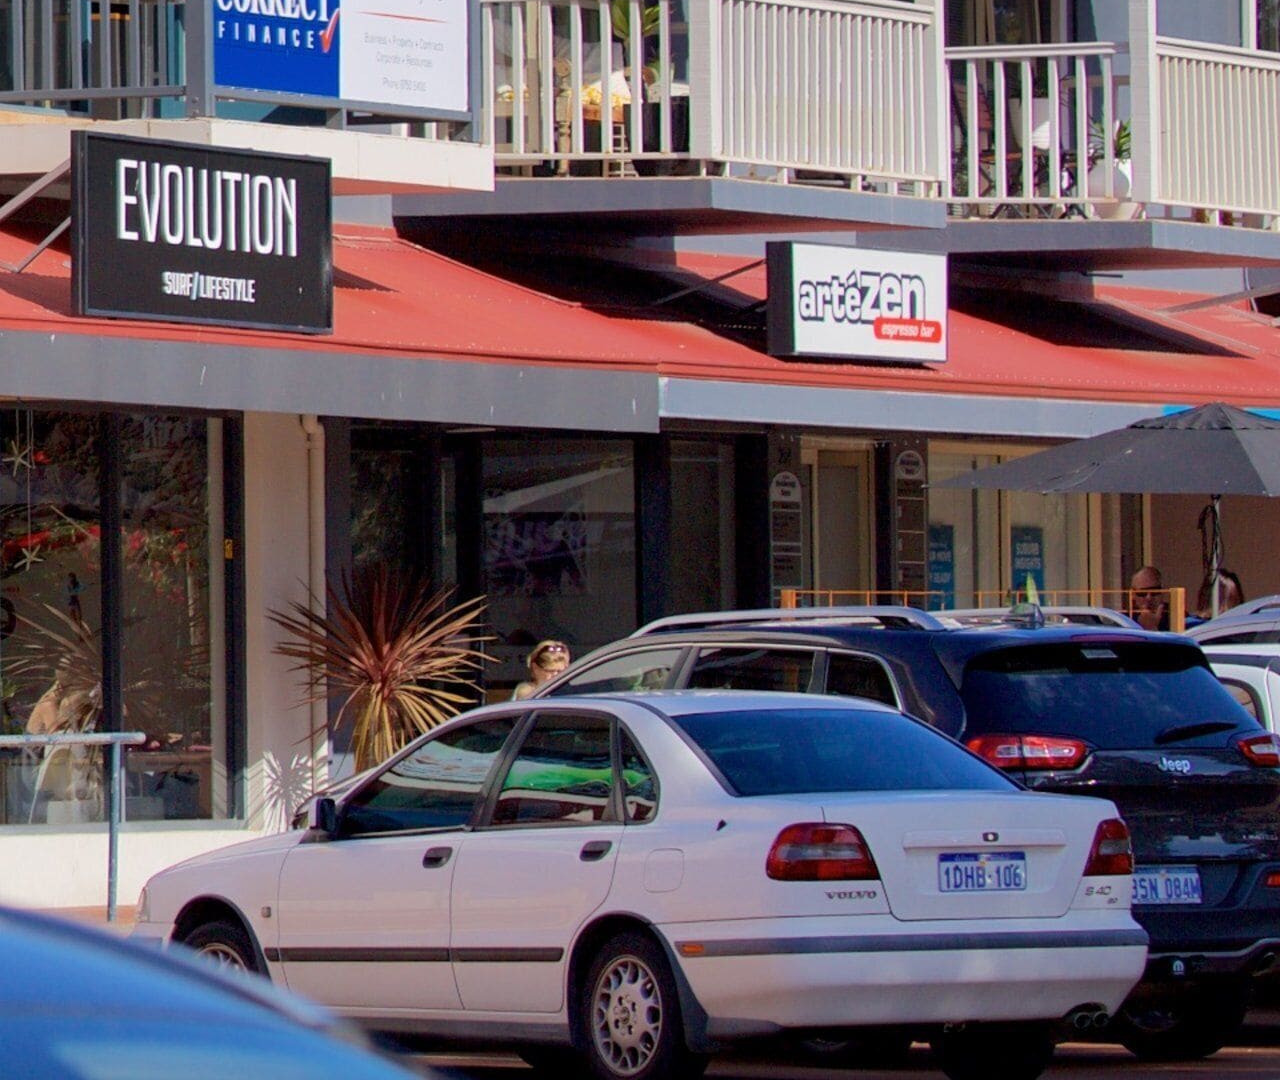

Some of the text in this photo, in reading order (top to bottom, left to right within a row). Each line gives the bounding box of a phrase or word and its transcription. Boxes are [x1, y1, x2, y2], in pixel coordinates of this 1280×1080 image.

[217, 20, 316, 50] FINANCE
[115, 158, 298, 258] EVOLUTION
[162, 271, 256, 303] SURF/LIFESTYLE
[799, 269, 926, 325] artézen
[880, 321, 936, 338] espresso bar
[1158, 756, 1191, 775] Jeep
[823, 890, 878, 900] VOLVO
